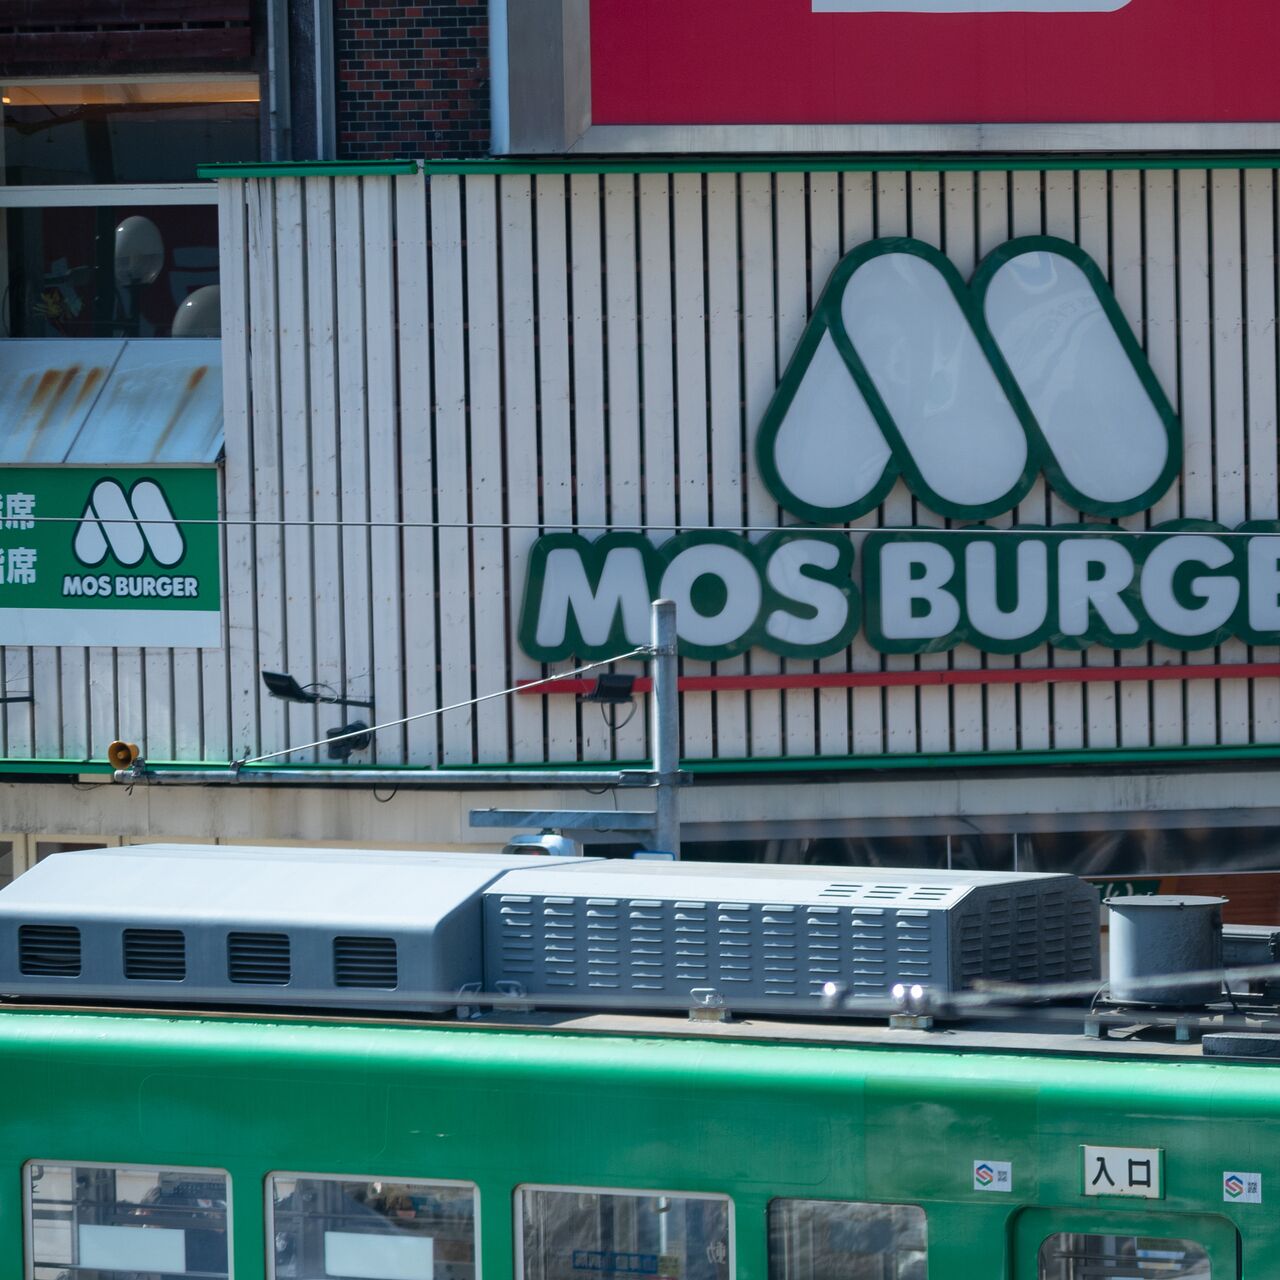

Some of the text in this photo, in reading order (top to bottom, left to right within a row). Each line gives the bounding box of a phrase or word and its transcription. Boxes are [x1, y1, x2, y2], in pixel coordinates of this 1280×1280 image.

[63, 575, 199, 598] MOS BURGER
[534, 538, 849, 647] MOS
[1092, 1156, 1151, 1188] 入口
